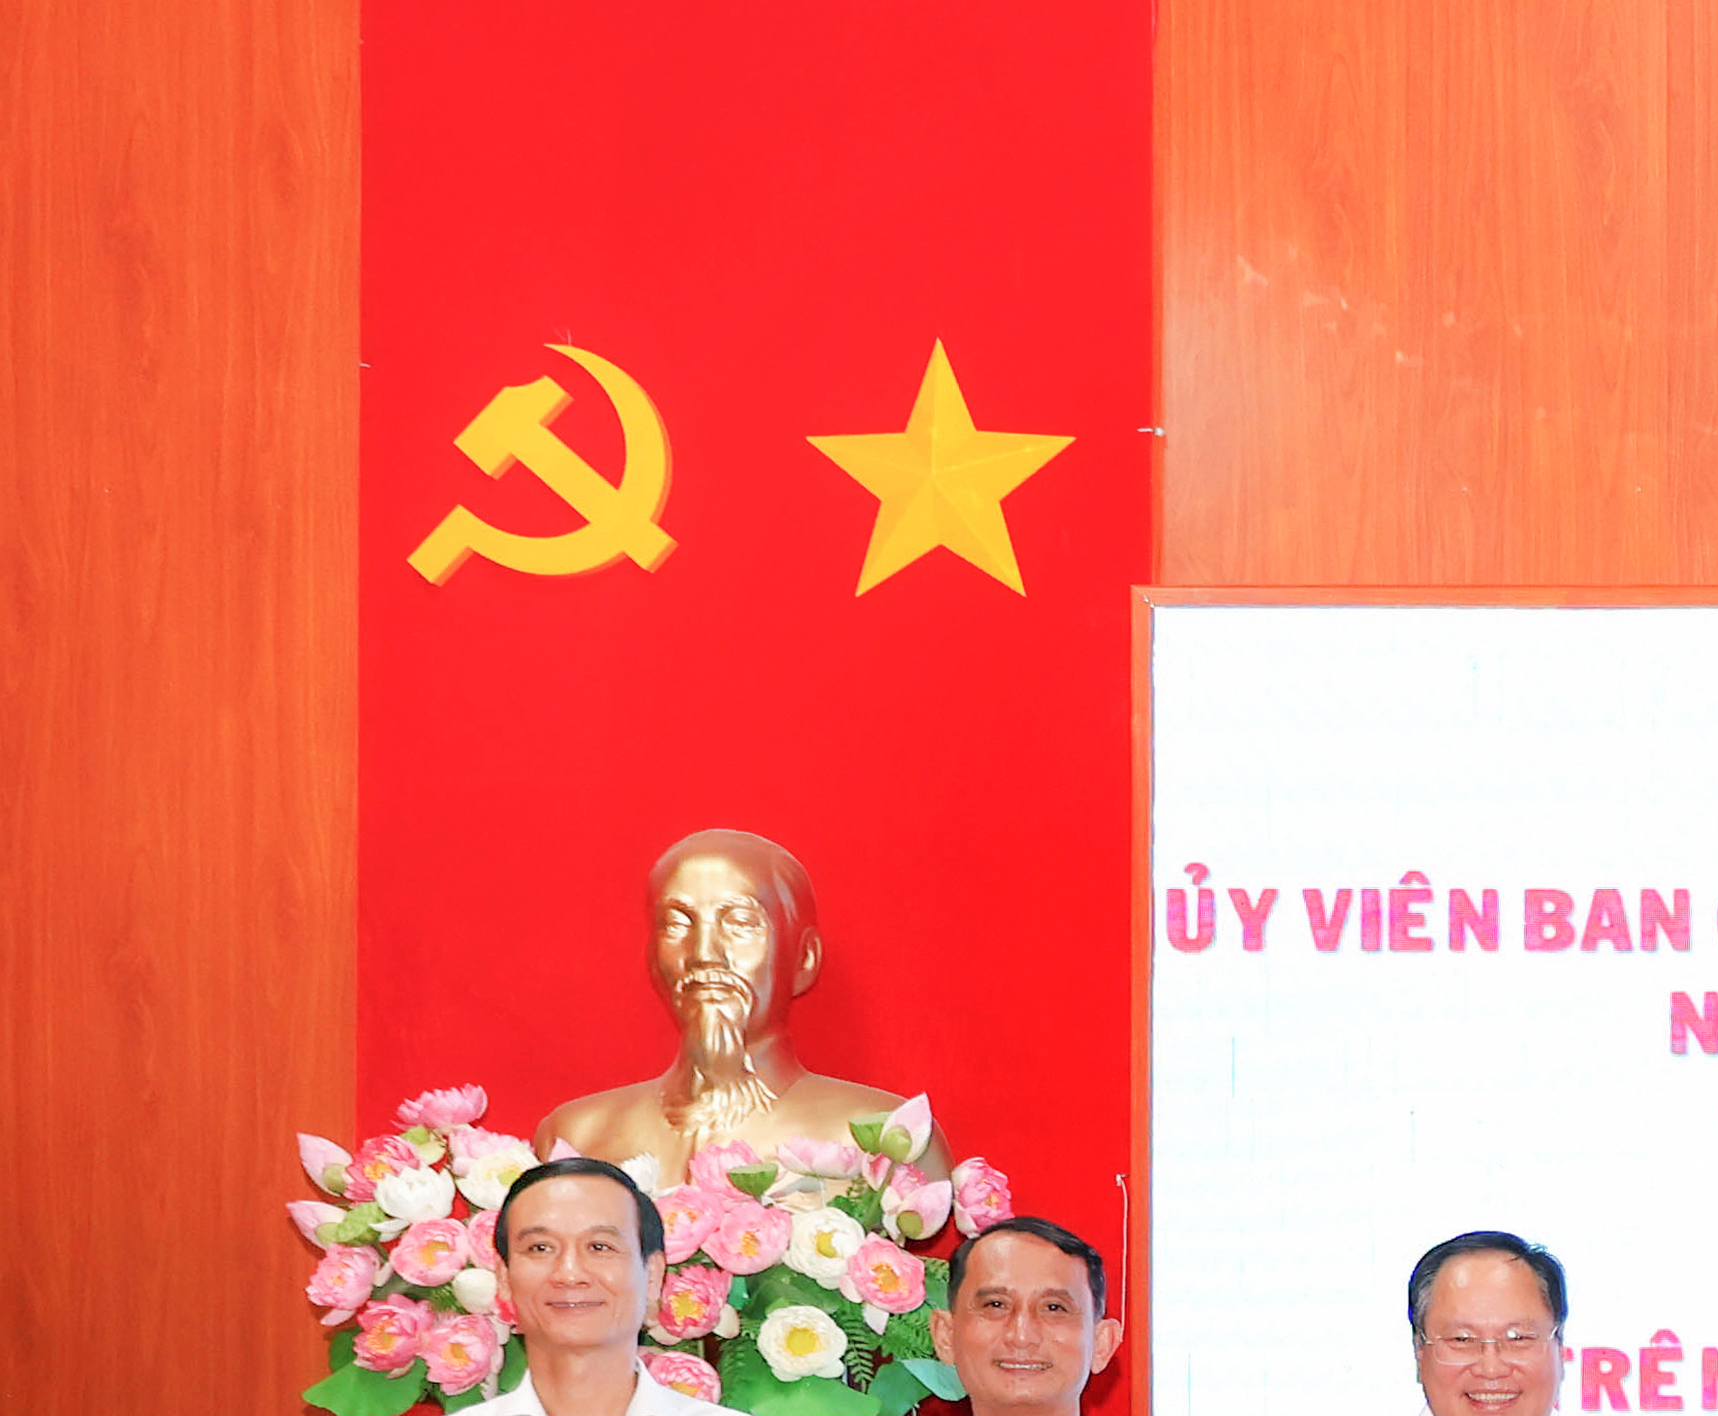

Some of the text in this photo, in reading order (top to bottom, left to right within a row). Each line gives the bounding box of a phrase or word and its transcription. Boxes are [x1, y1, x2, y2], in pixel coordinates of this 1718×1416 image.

[1166, 862, 1278, 953] ỦY
[1302, 870, 1499, 952] VIÊN
[1523, 888, 1691, 952] BAN
